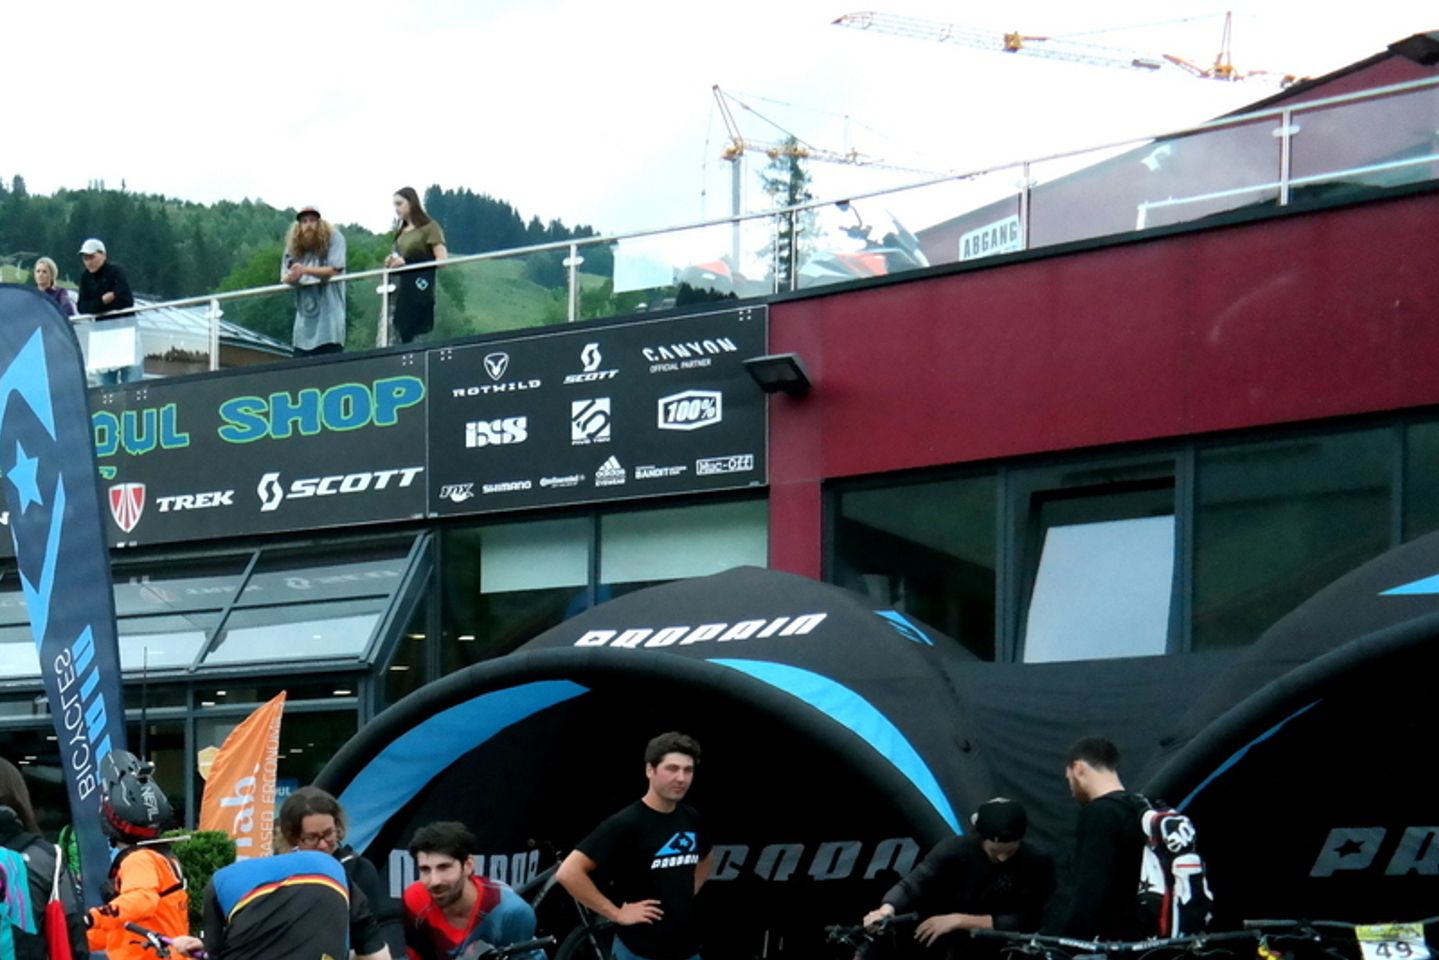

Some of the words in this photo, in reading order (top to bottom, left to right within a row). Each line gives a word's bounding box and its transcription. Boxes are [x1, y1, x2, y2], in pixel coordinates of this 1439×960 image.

[963, 220, 1018, 259] ABGANG
[642, 337, 738, 362] CANYON
[563, 369, 619, 384] SCOTT
[649, 363, 679, 374] OFFICIAL
[680, 358, 712, 370] PARTNER
[452, 379, 542, 398] ROTWILD
[91, 403, 190, 458] OUL
[217, 376, 426, 444] SHOP
[666, 398, 716, 423] 100%
[286, 467, 424, 499] SCOTT
[156, 490, 235, 513] TREK
[574, 613, 828, 648] PROPAIN
[1375, 940, 1414, 959] 49
